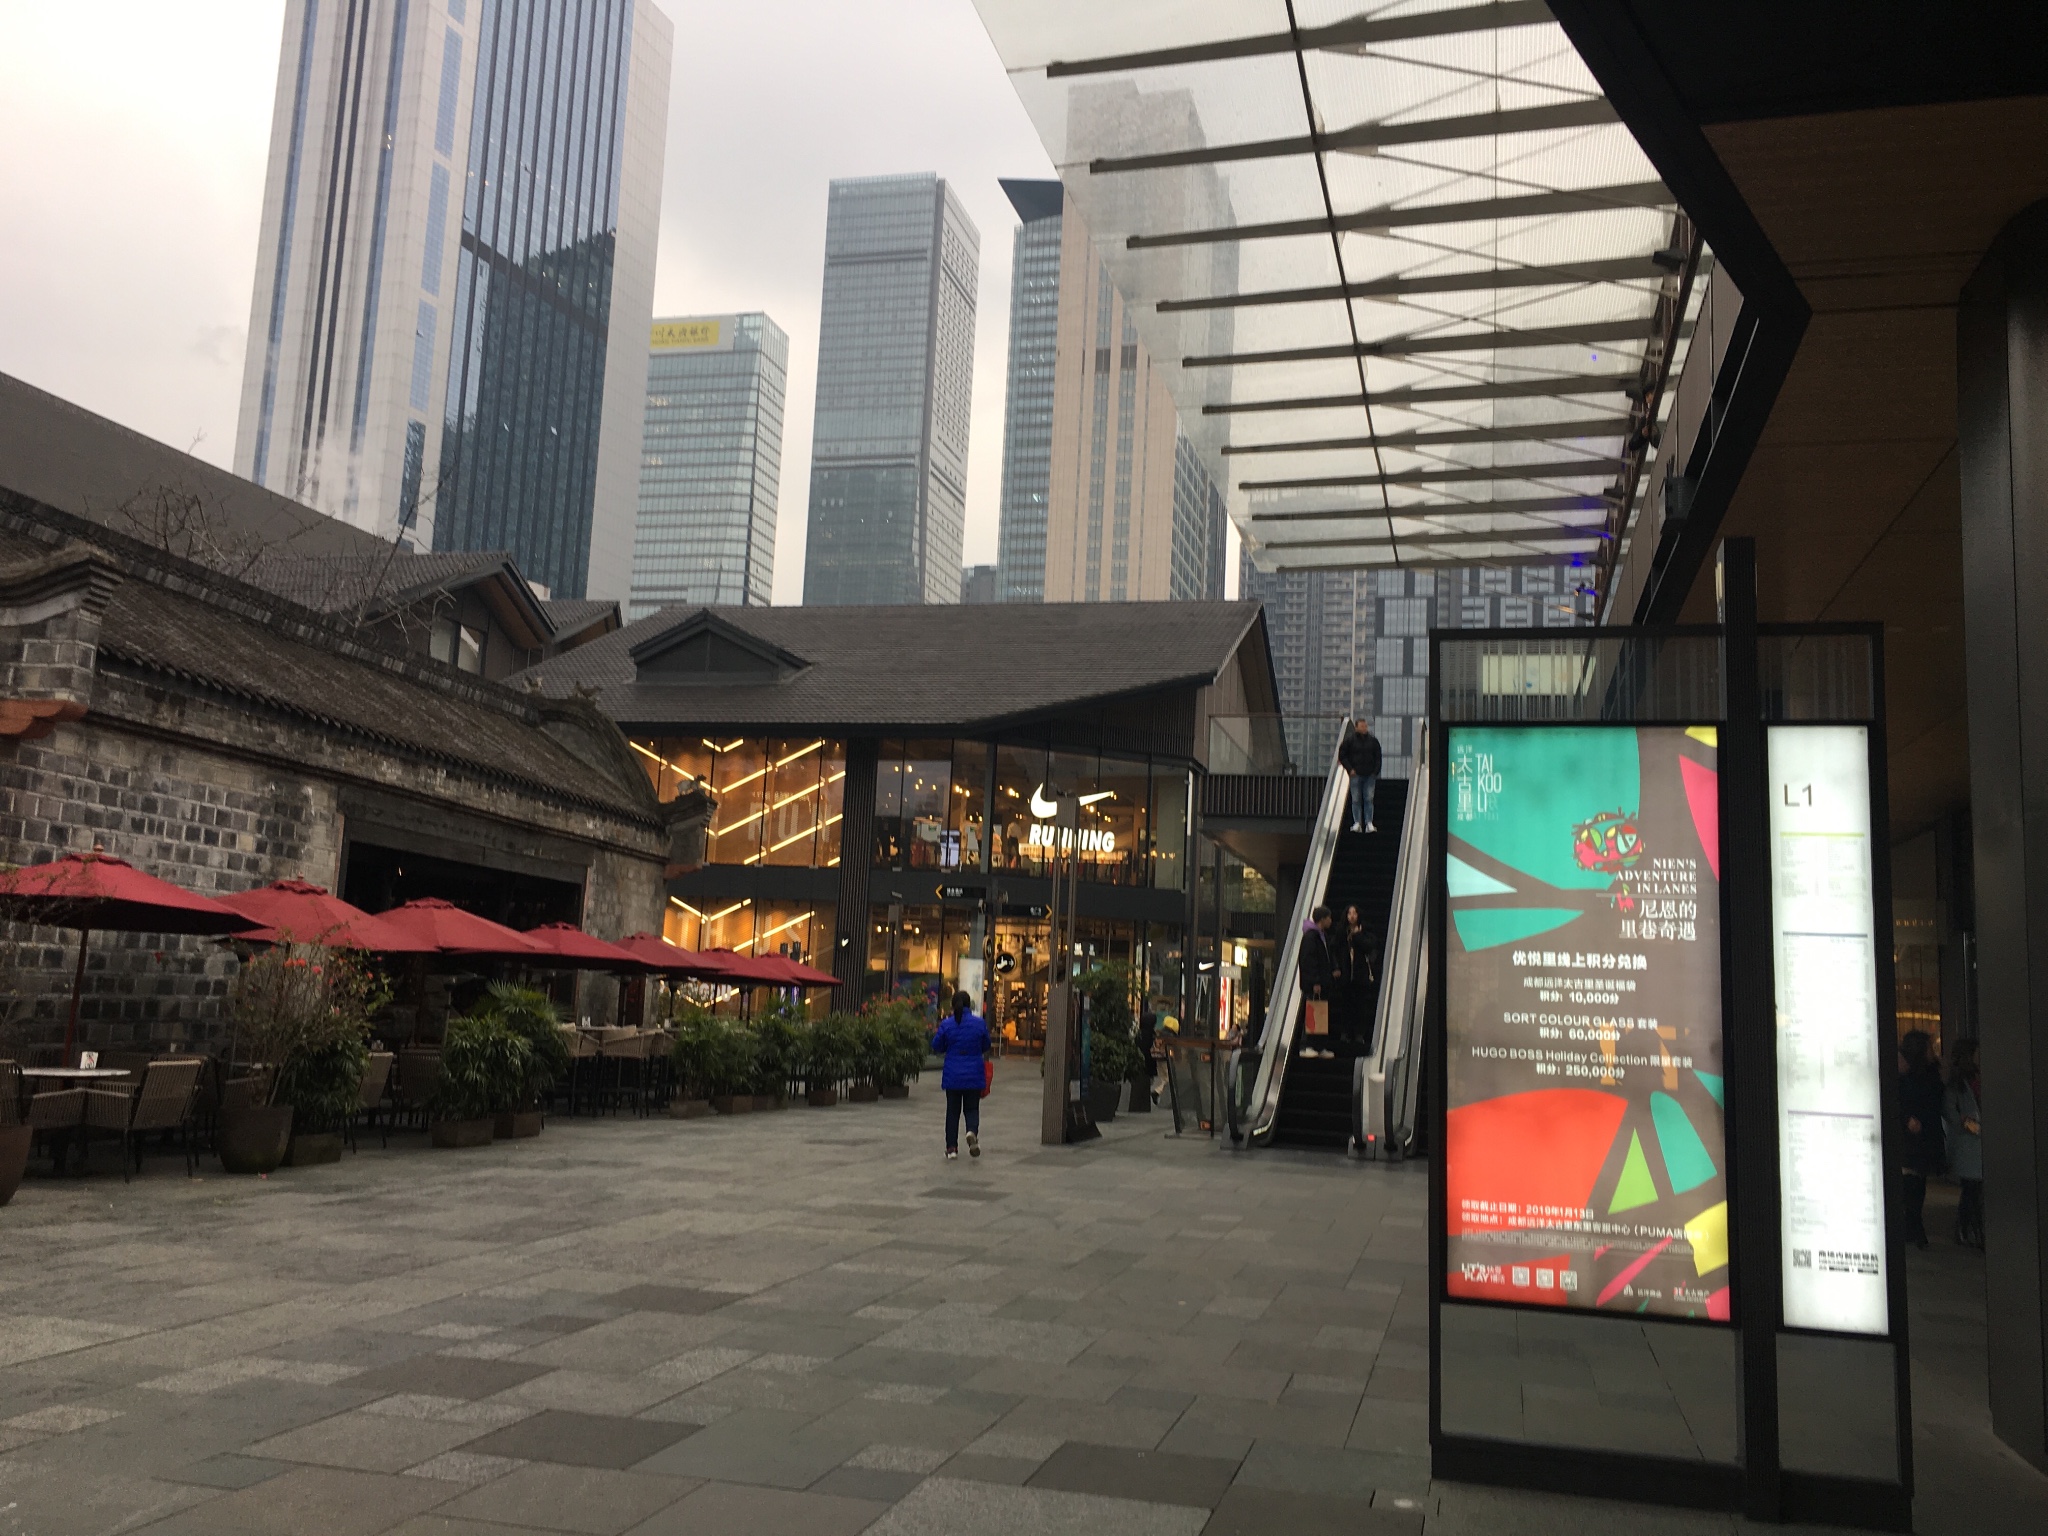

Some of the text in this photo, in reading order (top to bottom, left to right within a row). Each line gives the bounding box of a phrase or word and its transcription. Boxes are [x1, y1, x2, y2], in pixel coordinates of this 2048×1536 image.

[1475, 753, 1493, 773] TAI
[1477, 772, 1502, 794] KOO
[1477, 792, 1488, 812] LI
[1784, 783, 1812, 807] L1
[1616, 870, 1697, 882] ADVENTURE
[1637, 882, 1650, 894] IN
[1639, 899, 1697, 919] 尼恩的
[1619, 919, 1697, 942] 里巷奇遇
[1512, 950, 1647, 970] 优悦里线上积分兑换
[1539, 1013, 1590, 1026] COLOUR
[1472, 1047, 1507, 1059] HUGO
[1510, 1048, 1543, 1061] BOSS
[1546, 1049, 1587, 1064] Holiday
[1590, 1052, 1647, 1066] Collection
